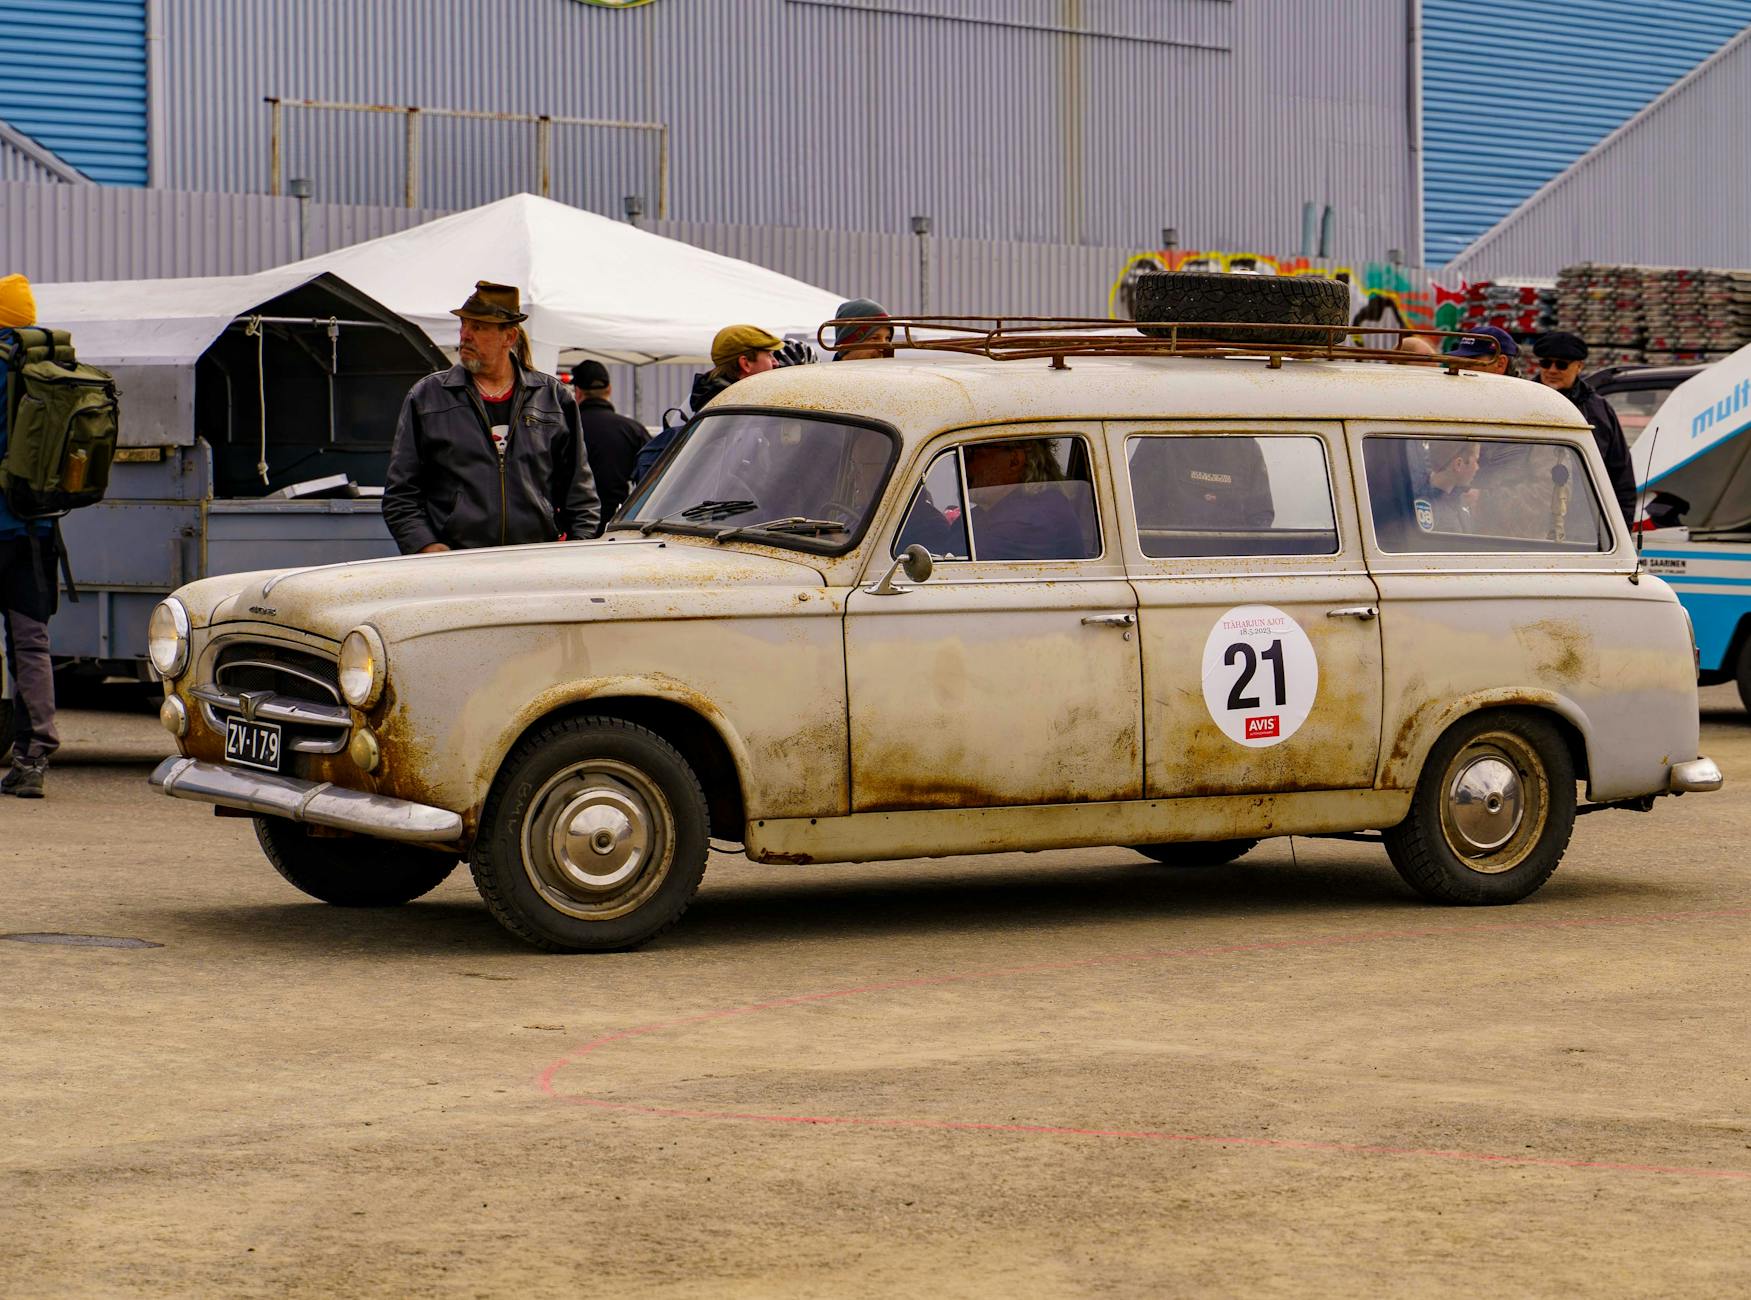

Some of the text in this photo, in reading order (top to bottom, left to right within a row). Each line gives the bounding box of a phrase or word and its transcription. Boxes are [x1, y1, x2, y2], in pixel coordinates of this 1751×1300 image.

[1224, 617, 1285, 630] ITÄHARJUN AJOT
[1240, 627, 1271, 636] 18.5.2023
[1224, 639, 1286, 710] 21
[1249, 718, 1275, 731] AVIS
